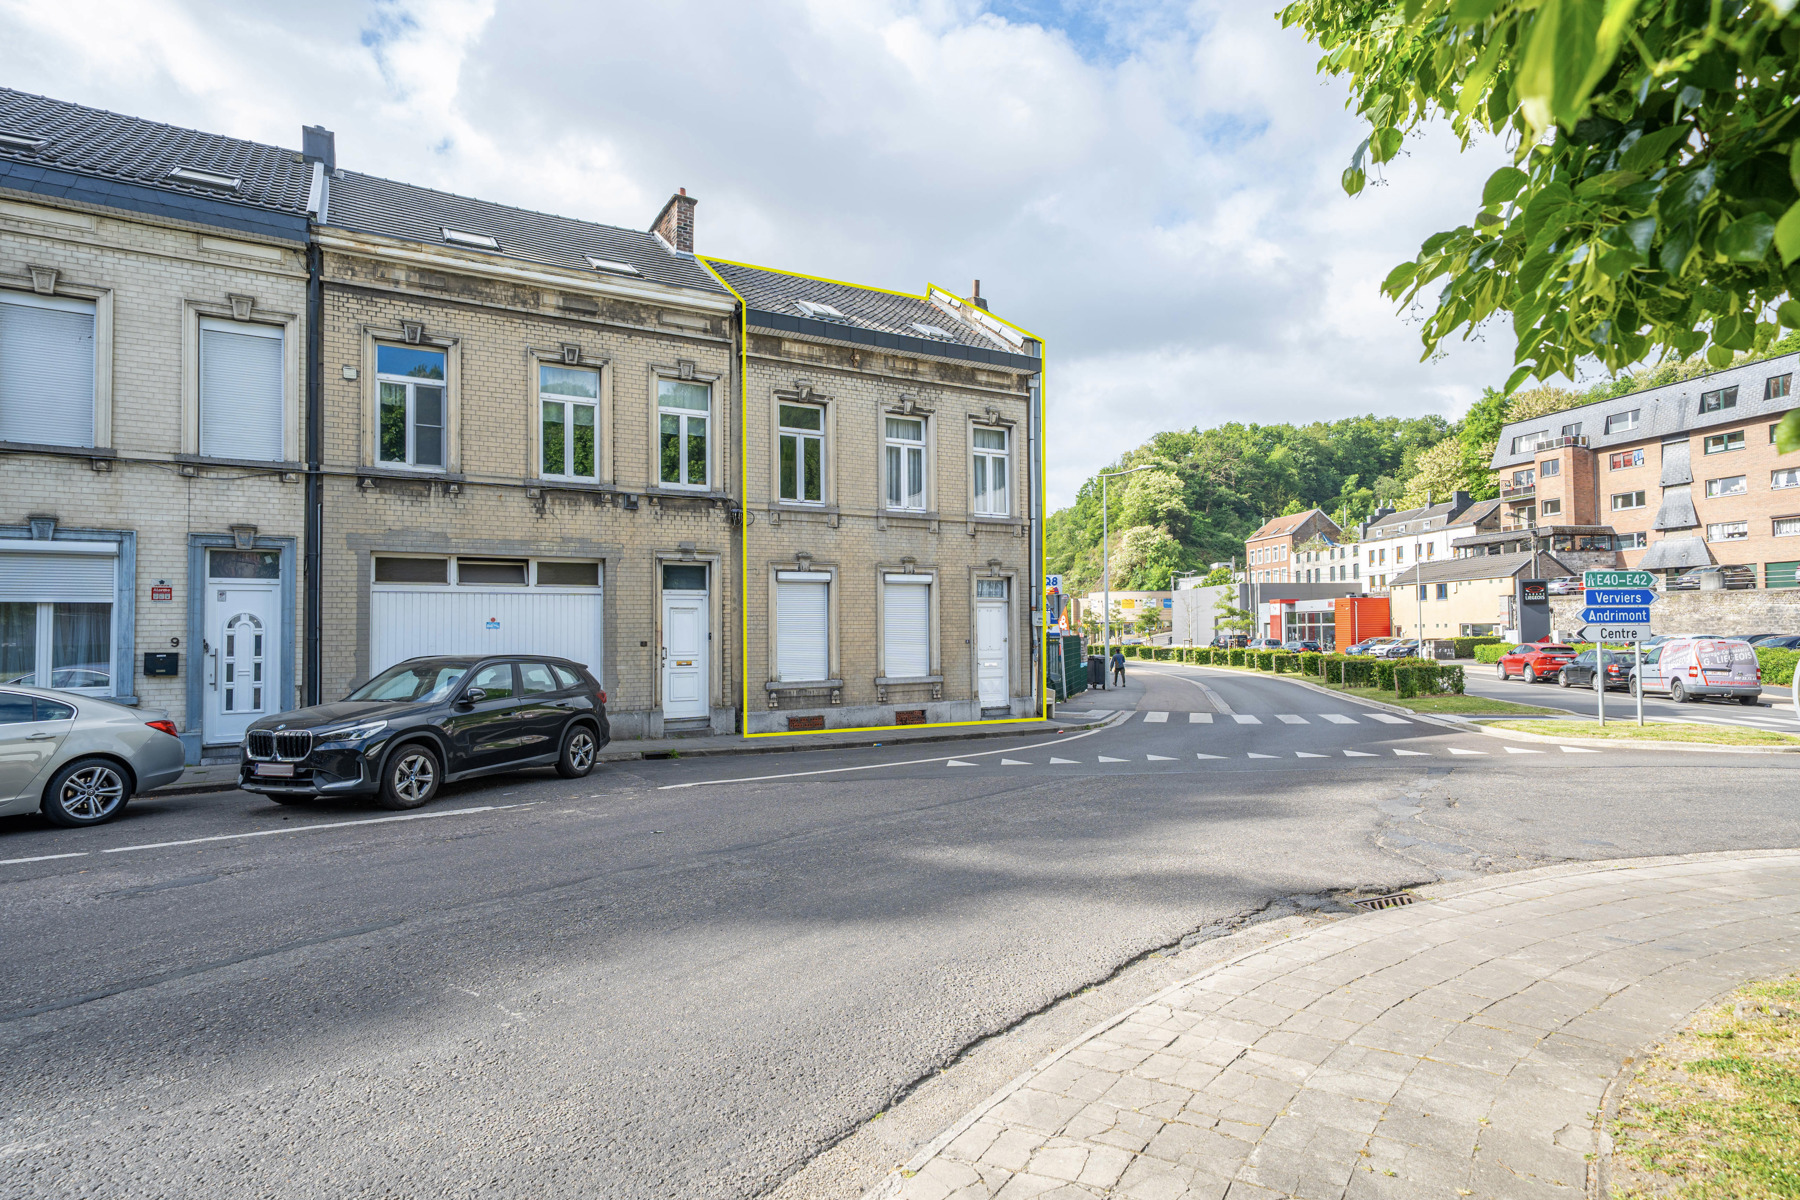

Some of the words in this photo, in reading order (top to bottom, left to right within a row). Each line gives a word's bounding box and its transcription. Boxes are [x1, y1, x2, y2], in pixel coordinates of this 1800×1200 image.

[1597, 574, 1648, 586] E40-E42
[1595, 592, 1642, 603] Verviers
[1588, 610, 1648, 621] Andrimont
[1600, 627, 1638, 639] Centre
[170, 637, 180, 648] 9
